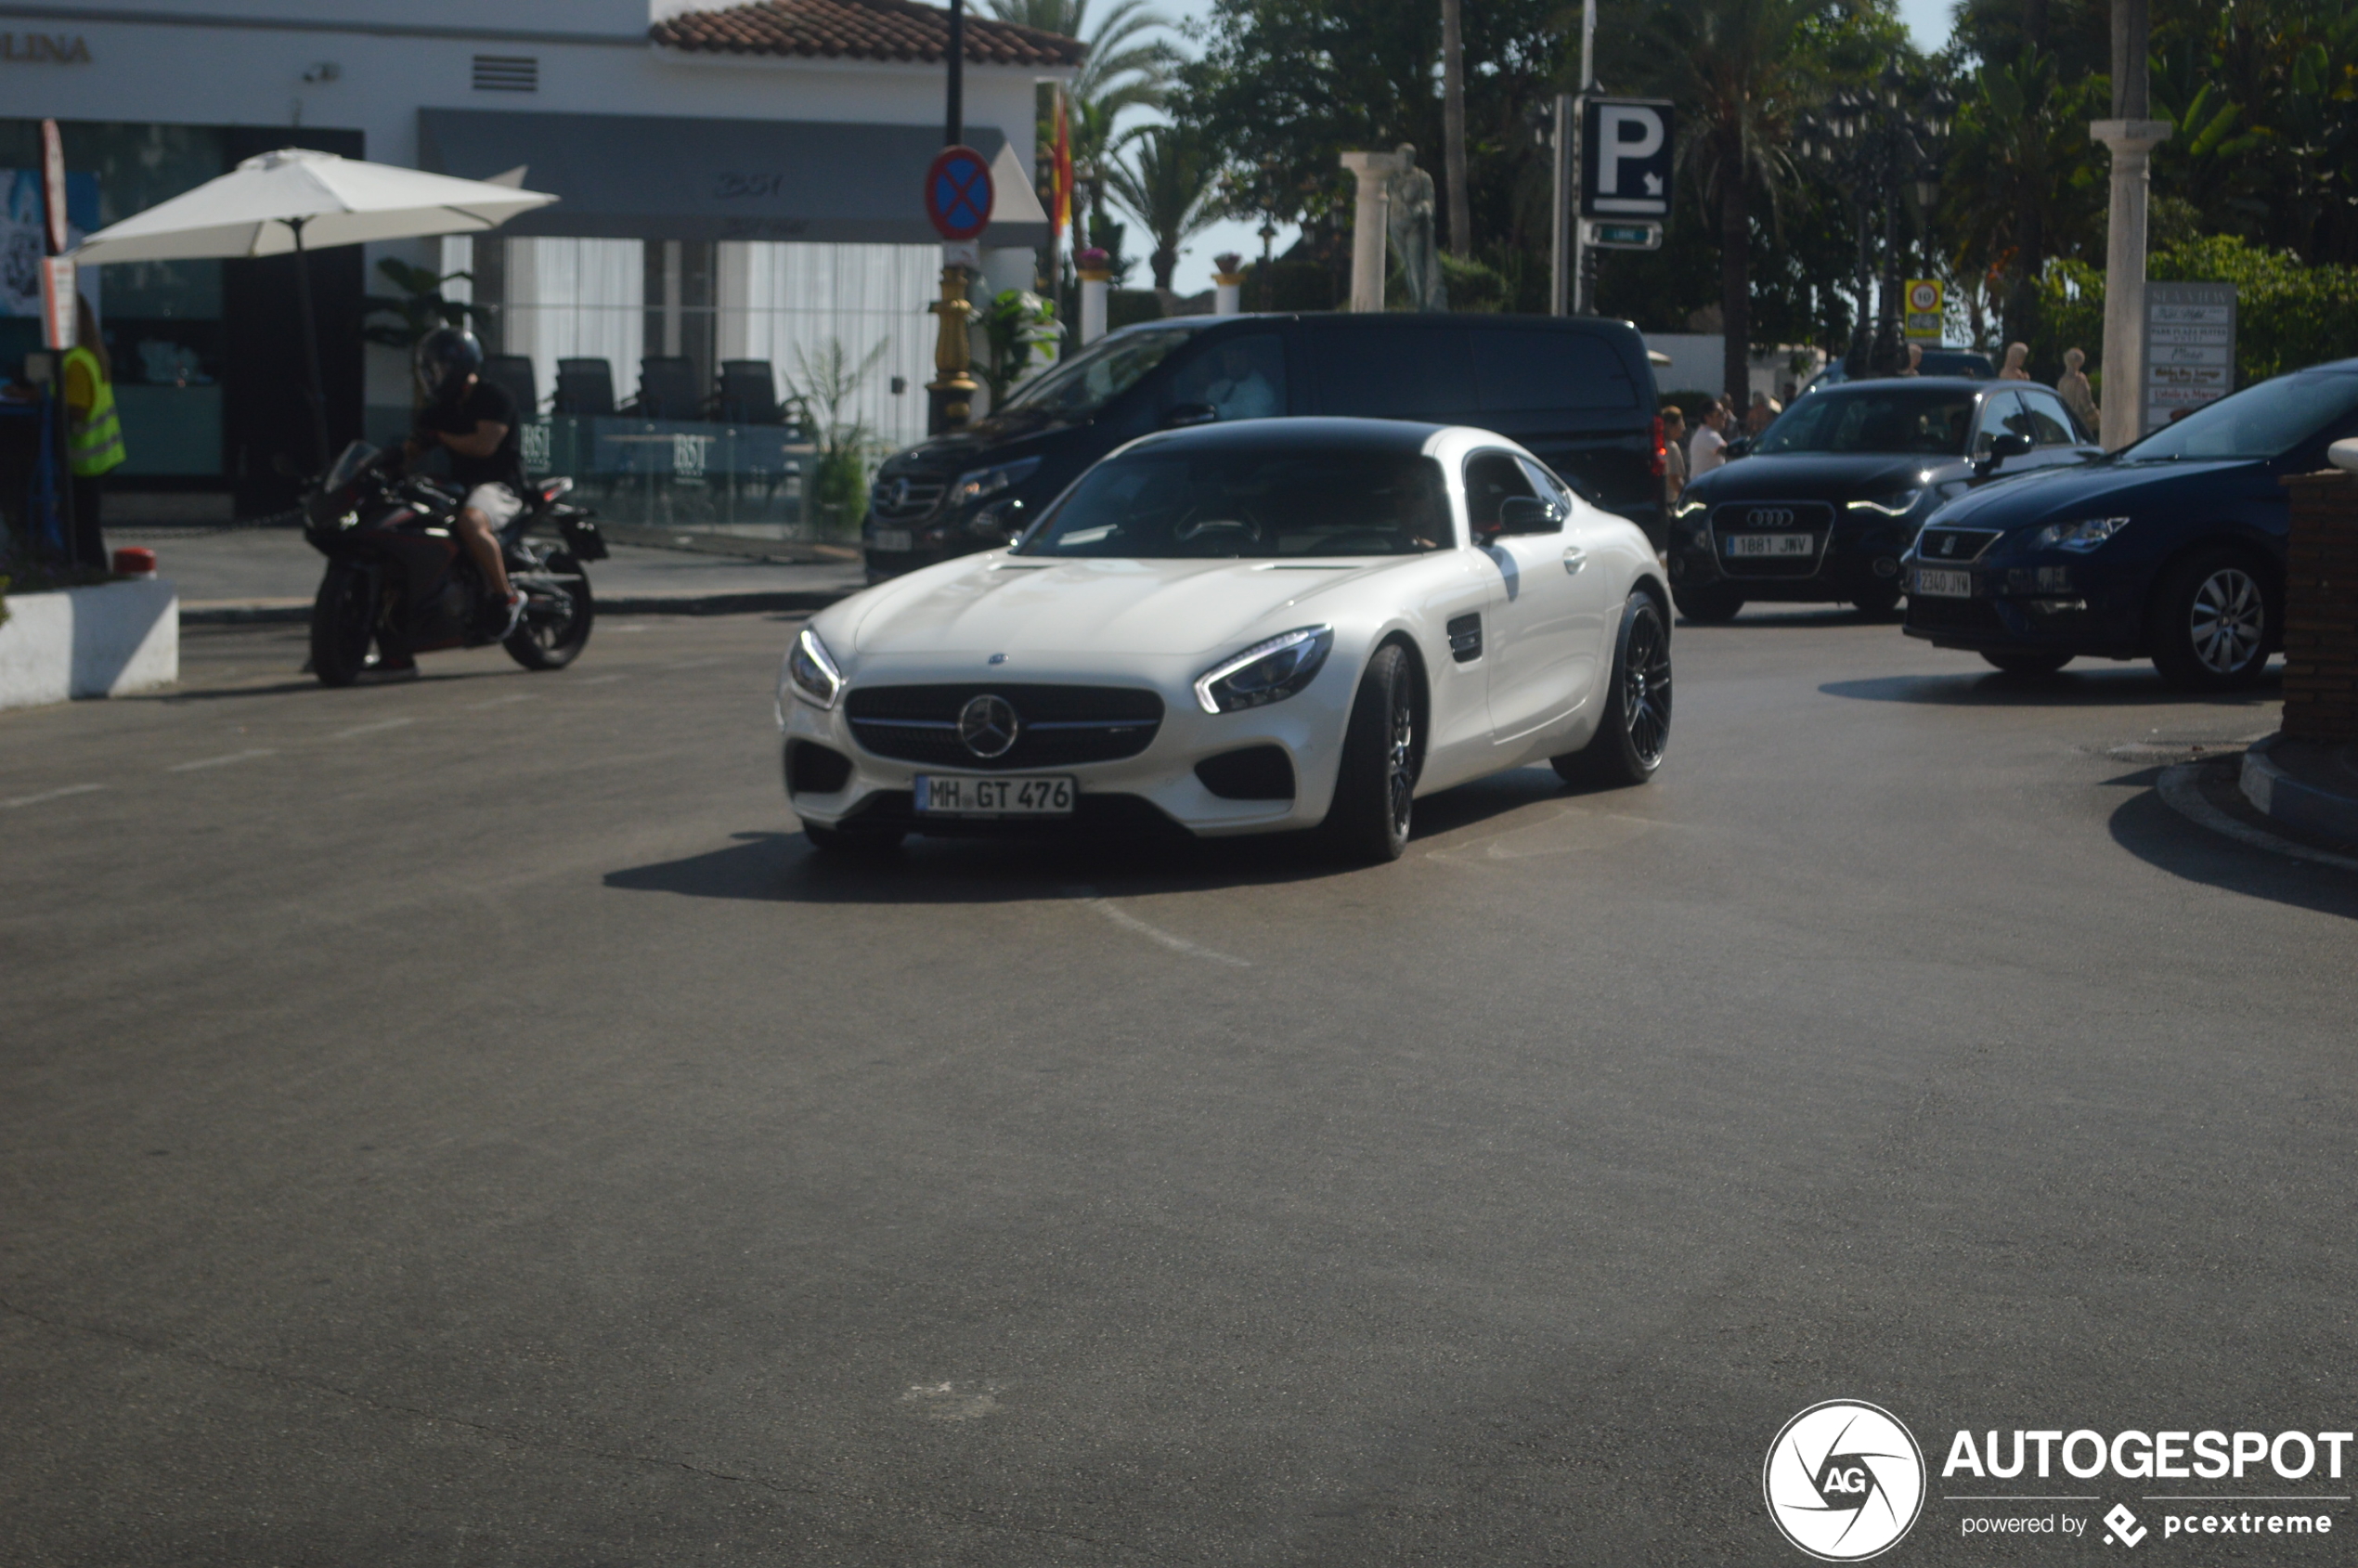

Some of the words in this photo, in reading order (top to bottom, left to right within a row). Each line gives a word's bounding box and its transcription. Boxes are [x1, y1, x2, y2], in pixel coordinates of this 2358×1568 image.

[0, 32, 91, 64] LINA
[1599, 106, 1665, 194] P
[1741, 537, 1771, 552] 1881
[930, 780, 960, 807] MH
[977, 780, 1011, 808] GT
[1017, 781, 1070, 808] 476
